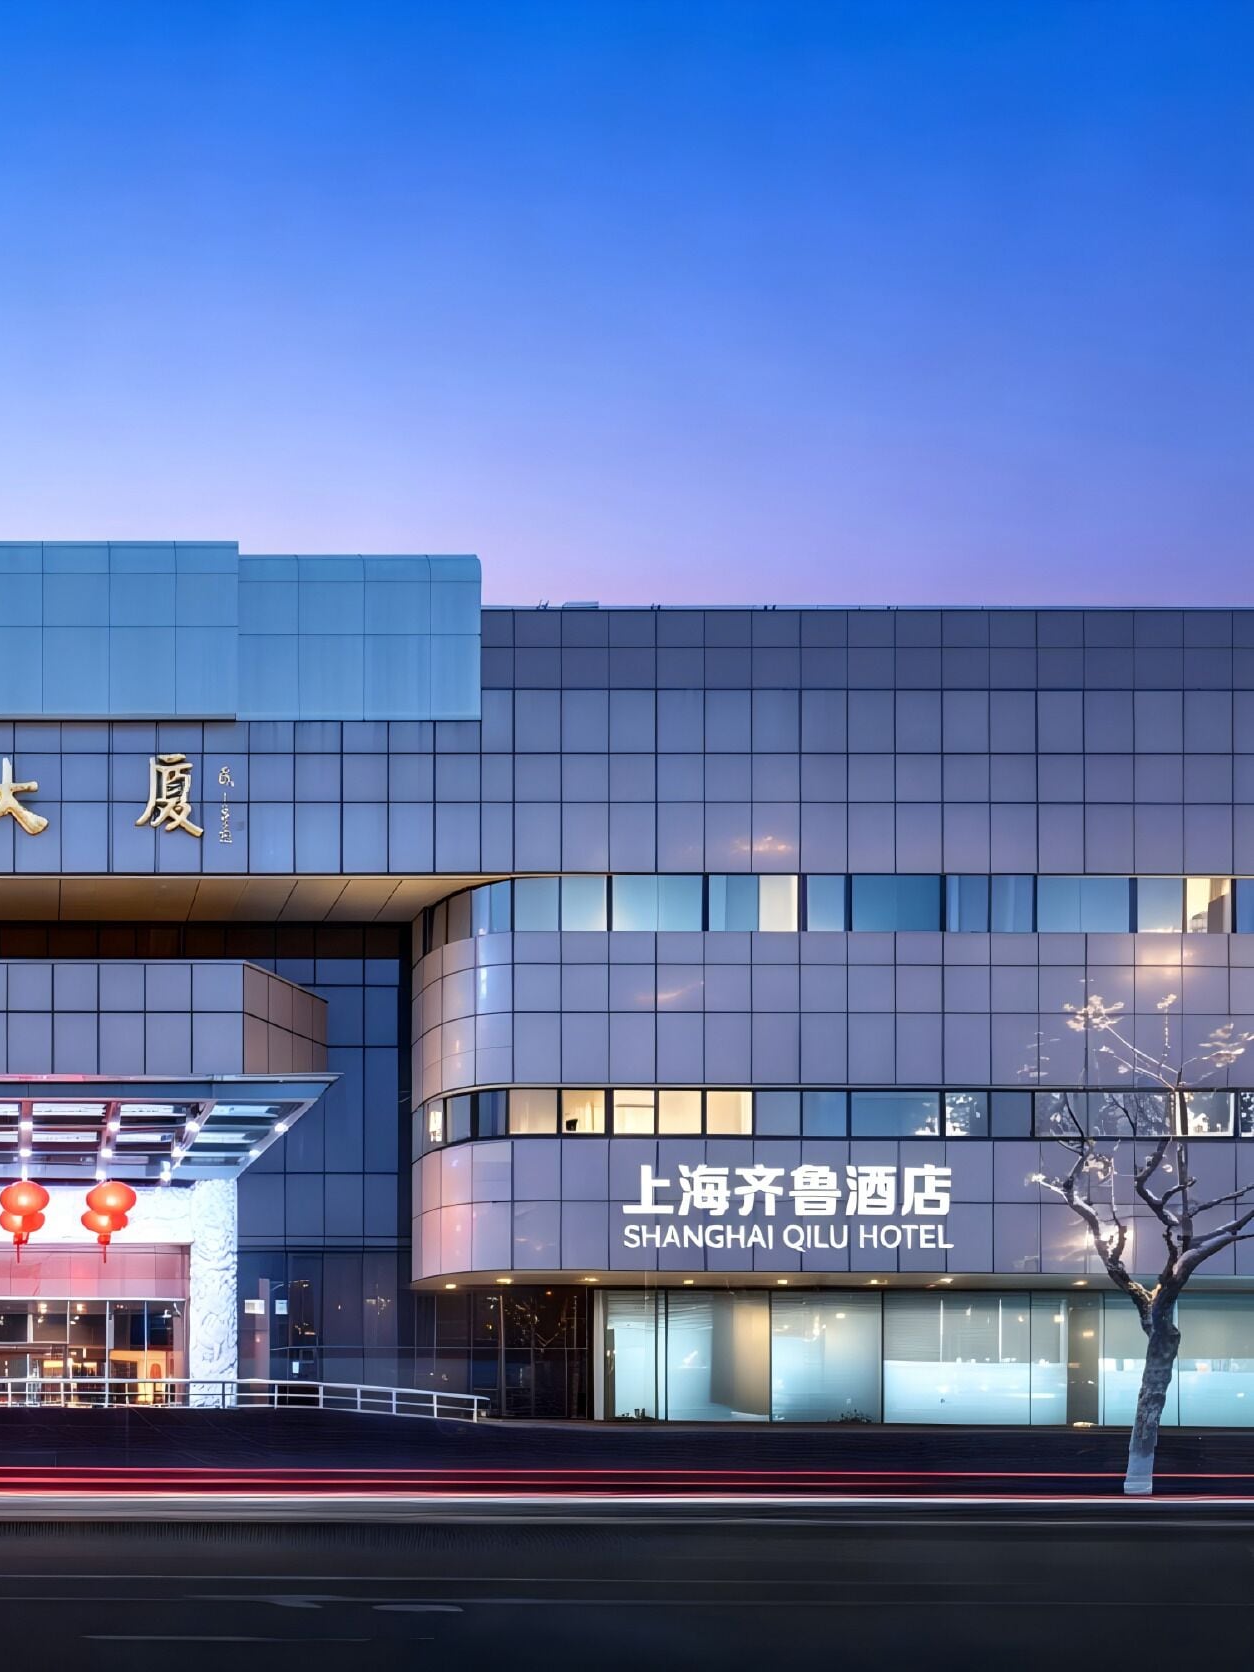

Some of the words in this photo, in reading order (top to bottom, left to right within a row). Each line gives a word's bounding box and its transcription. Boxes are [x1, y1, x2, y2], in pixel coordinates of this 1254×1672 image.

[622, 1163, 952, 1216] 上海齐鲁酒店
[623, 1224, 774, 1249] SHANGHAI
[782, 1224, 848, 1252] QILU
[860, 1224, 954, 1249] HOTEL
